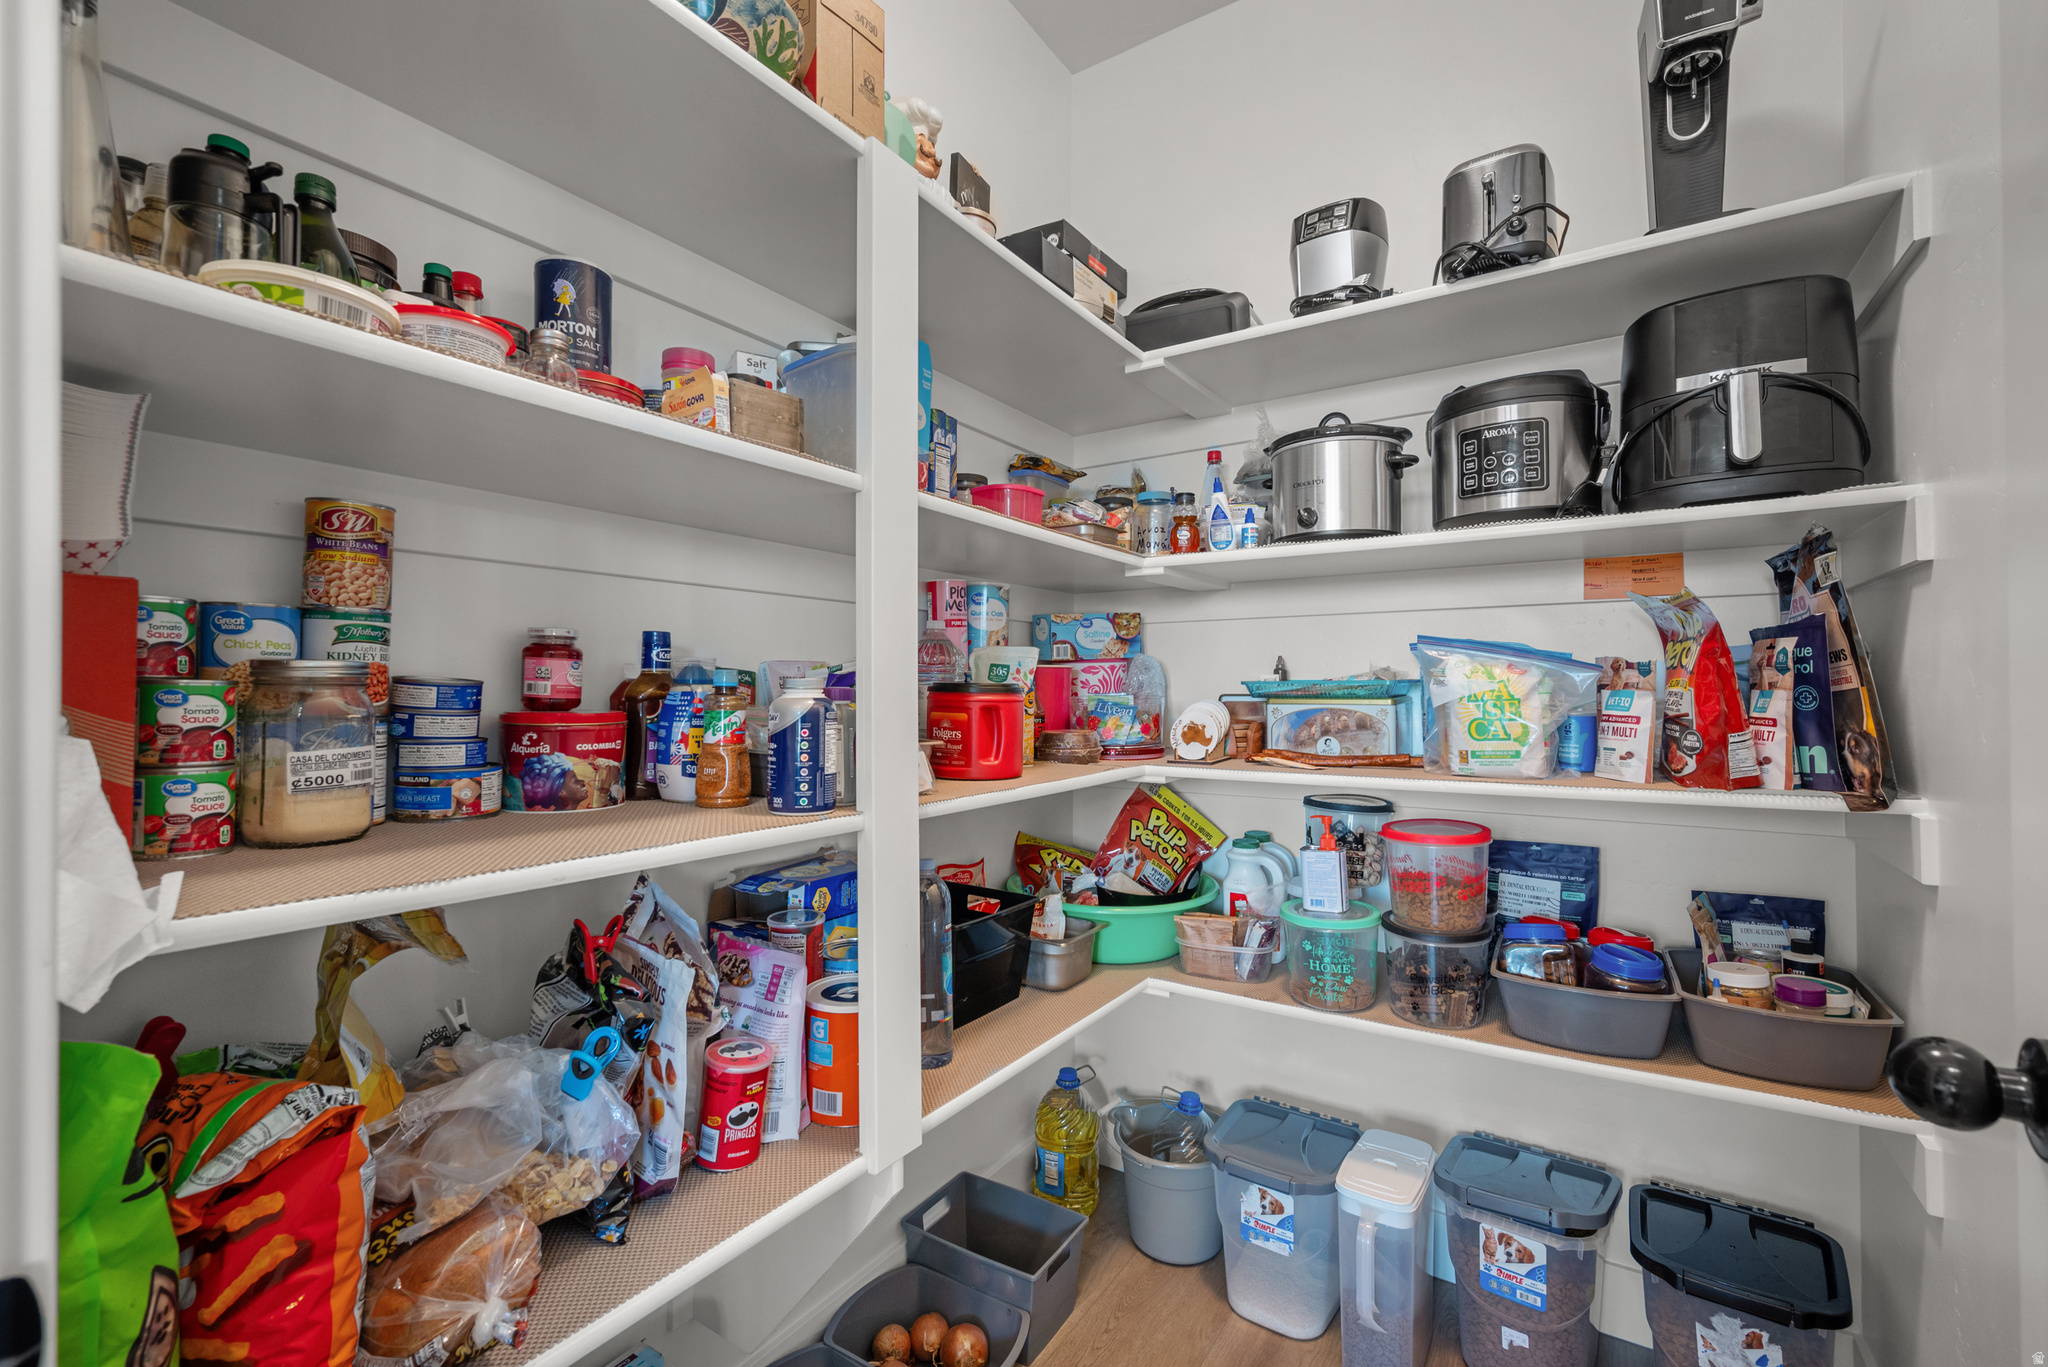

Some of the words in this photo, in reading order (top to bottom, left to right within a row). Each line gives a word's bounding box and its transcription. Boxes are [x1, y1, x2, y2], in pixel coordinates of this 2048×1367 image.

[854, 9, 878, 38] 34790
[538, 320, 597, 338] MORTON
[576, 338, 601, 351] SALT
[746, 357, 768, 370] Salt
[686, 393, 705, 407] GOYA
[1482, 425, 1517, 439] AROMA
[324, 510, 372, 532] S&W
[316, 537, 347, 547] WHITE
[349, 539, 379, 551] BEANS
[317, 551, 337, 559] Low
[339, 553, 376, 563] Sodium
[945, 600, 967, 612] Mel
[991, 610, 1004, 618] Oats
[215, 616, 245, 625] Great
[148, 624, 182, 632] Tomato
[221, 623, 246, 631] Value
[146, 630, 182, 640] Sauce
[1083, 630, 1111, 639] Saltine
[223, 638, 262, 650] Chick
[266, 639, 292, 650] Peas
[354, 645, 377, 654] Light
[326, 651, 377, 661] KIDNEY
[990, 666, 1008, 676] 365
[158, 692, 183, 701] Great
[183, 708, 219, 716] Tomato
[1096, 702, 1133, 716] Livean
[1485, 700, 1520, 720] SE
[181, 715, 219, 724] Sauce
[932, 727, 962, 741] Folgers
[1470, 720, 1508, 739] CA
[1611, 726, 1638, 738] MULTI
[511, 741, 550, 754] Alquería
[649, 741, 658, 750] BA
[290, 756, 313, 765] CASA
[314, 755, 329, 763] DEL
[331, 750, 372, 761] CONDIMENTO
[166, 782, 192, 792] Great
[192, 794, 225, 803] Tomato
[413, 794, 441, 802] BREAST
[190, 802, 225, 813] Sauce
[1181, 811, 1191, 823] FOR
[1197, 826, 1214, 841] HOURS
[1129, 818, 1191, 875] Peroni
[1532, 872, 1559, 880] relentless
[1397, 880, 1433, 893] VIBES
[639, 956, 661, 979] SIMPLY
[1308, 958, 1351, 974] HOME
[631, 963, 667, 1007] DELICIOUS
[1409, 973, 1465, 985] Pawsitive
[1418, 984, 1456, 996] VIBES
[776, 1010, 789, 1019] like
[746, 1086, 764, 1096] FLAVOR
[723, 1122, 757, 1144] PRINGLES
[727, 1149, 750, 1158] ORIGINAL
